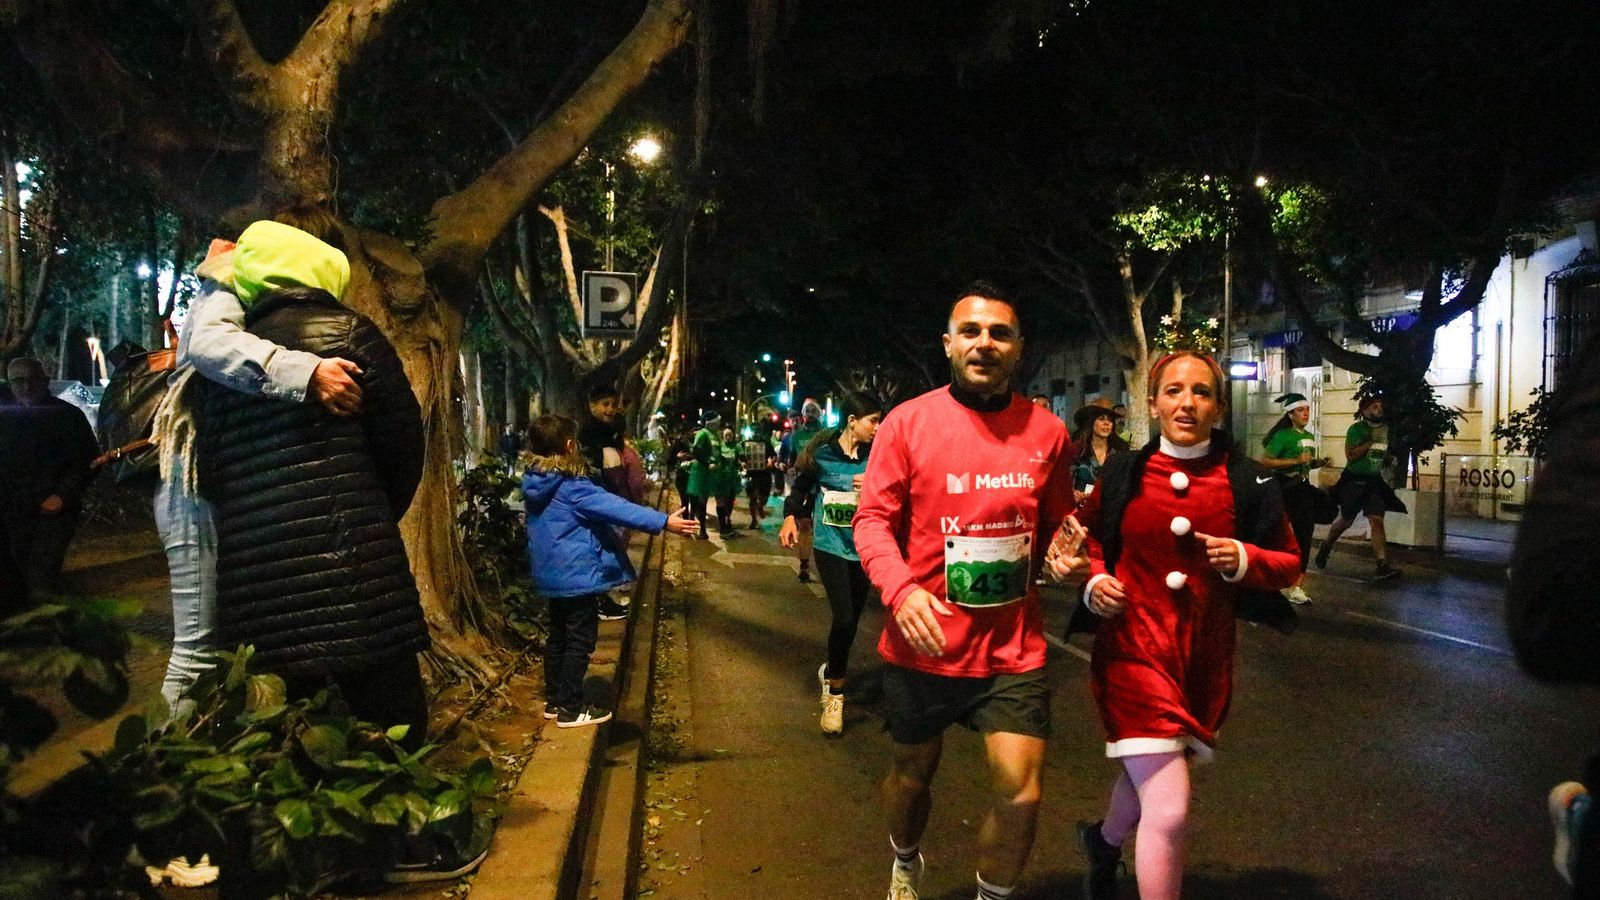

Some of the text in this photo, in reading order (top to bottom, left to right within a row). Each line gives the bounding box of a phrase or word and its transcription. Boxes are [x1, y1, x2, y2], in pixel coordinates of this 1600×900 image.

[588, 276, 631, 327] P
[976, 472, 1035, 490] MetLife
[1459, 468, 1515, 489] ROSSO
[940, 516, 961, 534] IX
[985, 521, 1014, 530] MADRID
[970, 571, 1008, 596] 43
